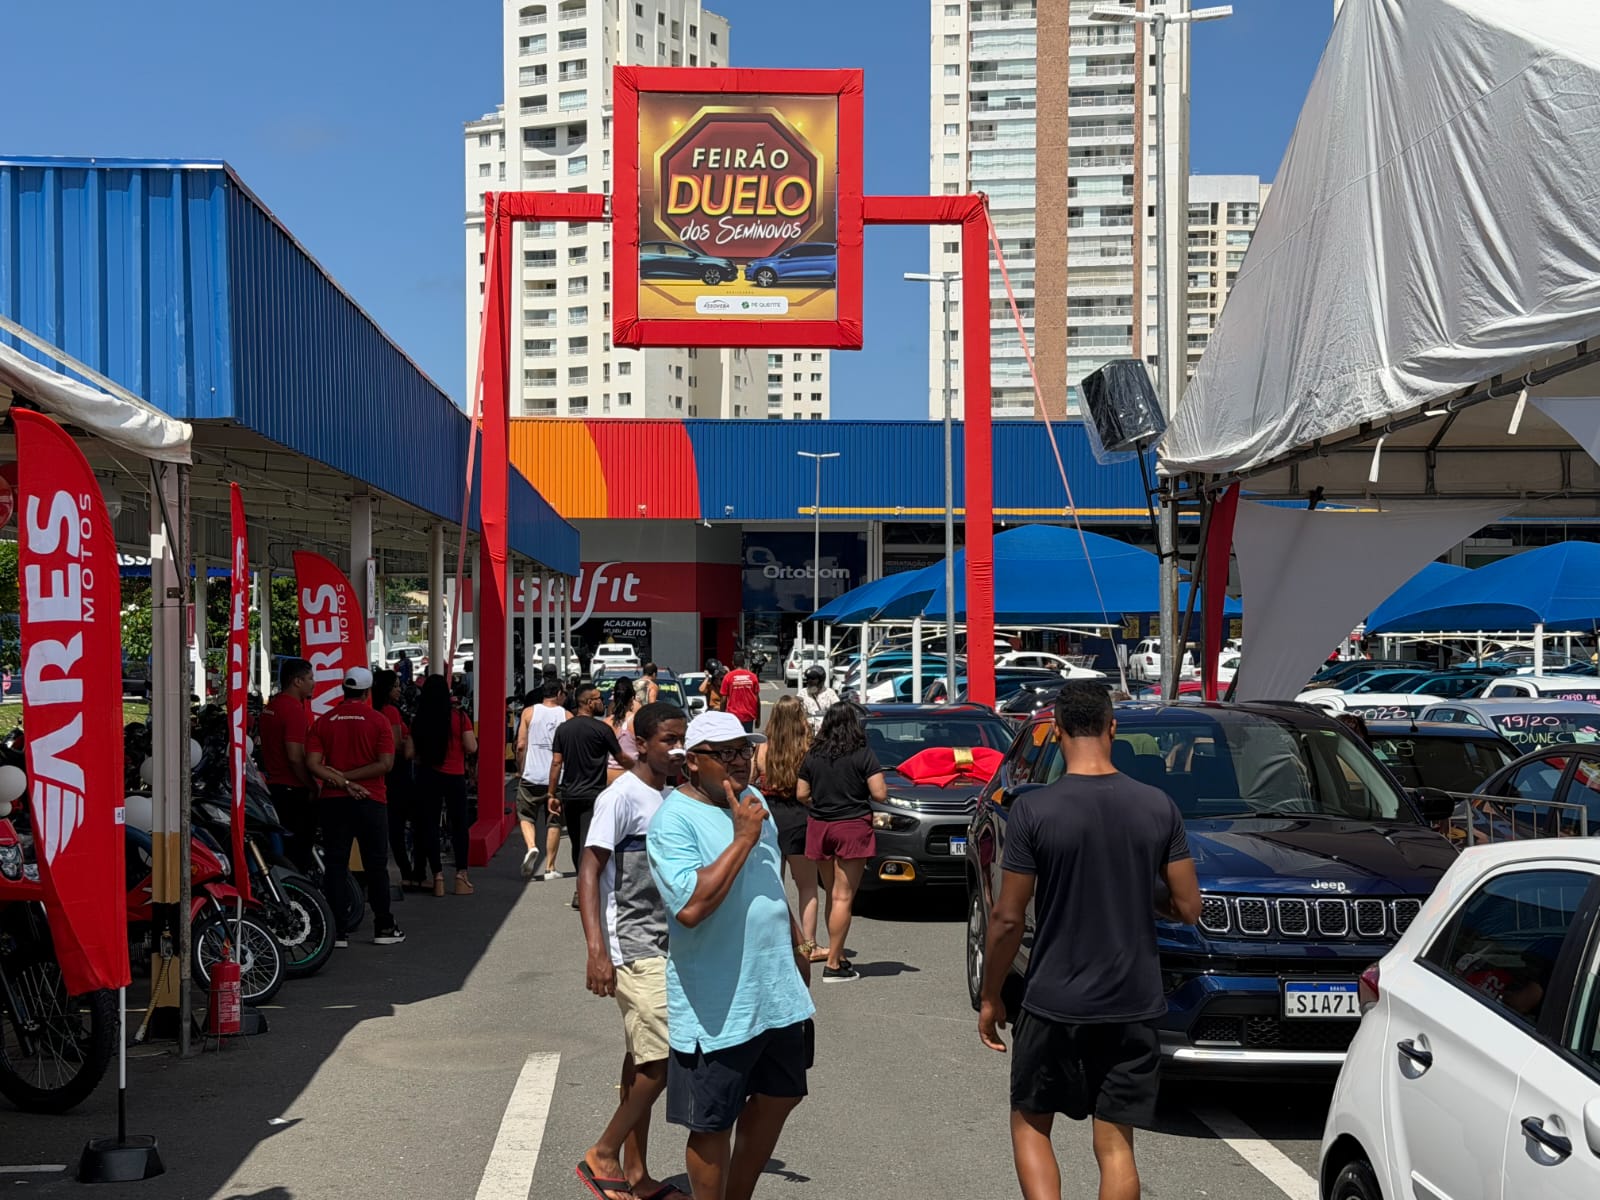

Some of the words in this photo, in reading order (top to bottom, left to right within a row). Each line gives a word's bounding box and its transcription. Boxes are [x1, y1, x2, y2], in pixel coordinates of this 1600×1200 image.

[692, 143, 789, 169] FEIRÃO
[667, 174, 812, 217] DUELO
[680, 219, 711, 241] dos
[80, 493, 95, 622] MOTOS
[763, 564, 850, 579] Ortobom
[336, 583, 350, 643] MOTOS
[24, 490, 85, 794] ARES
[622, 629, 647, 637] JEITO
[302, 584, 345, 719] ARES
[1502, 715, 1560, 728] 19/20
[1311, 879, 1346, 892] Jeep
